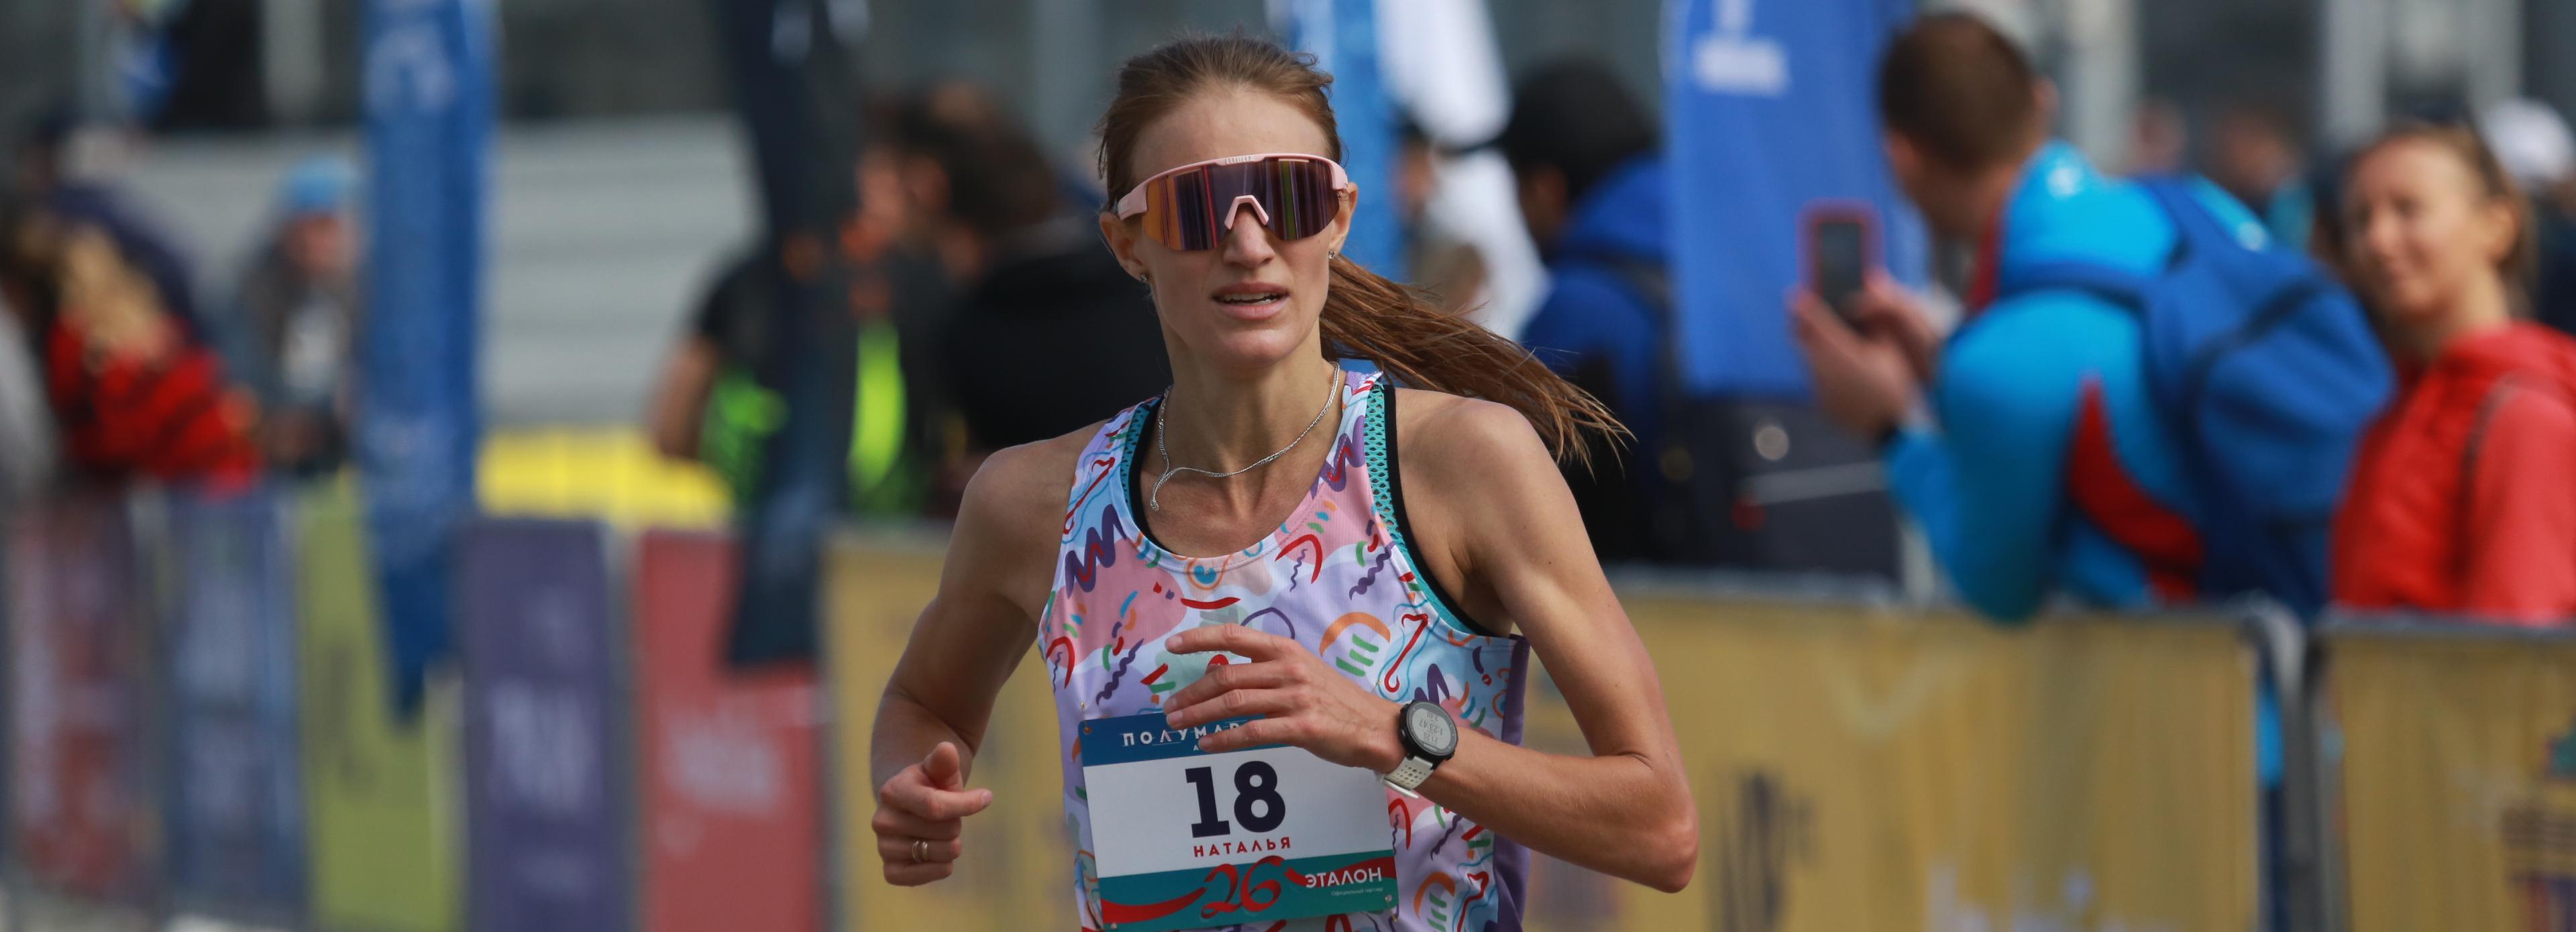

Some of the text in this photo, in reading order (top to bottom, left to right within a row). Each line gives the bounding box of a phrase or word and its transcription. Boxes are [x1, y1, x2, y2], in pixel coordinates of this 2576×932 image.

[1185, 760, 1286, 838] 18
[1193, 836, 1291, 858] НАТАЛЬЯ
[1201, 855, 1285, 919] 26
[1304, 866, 1382, 888] ЭТАЛОН
